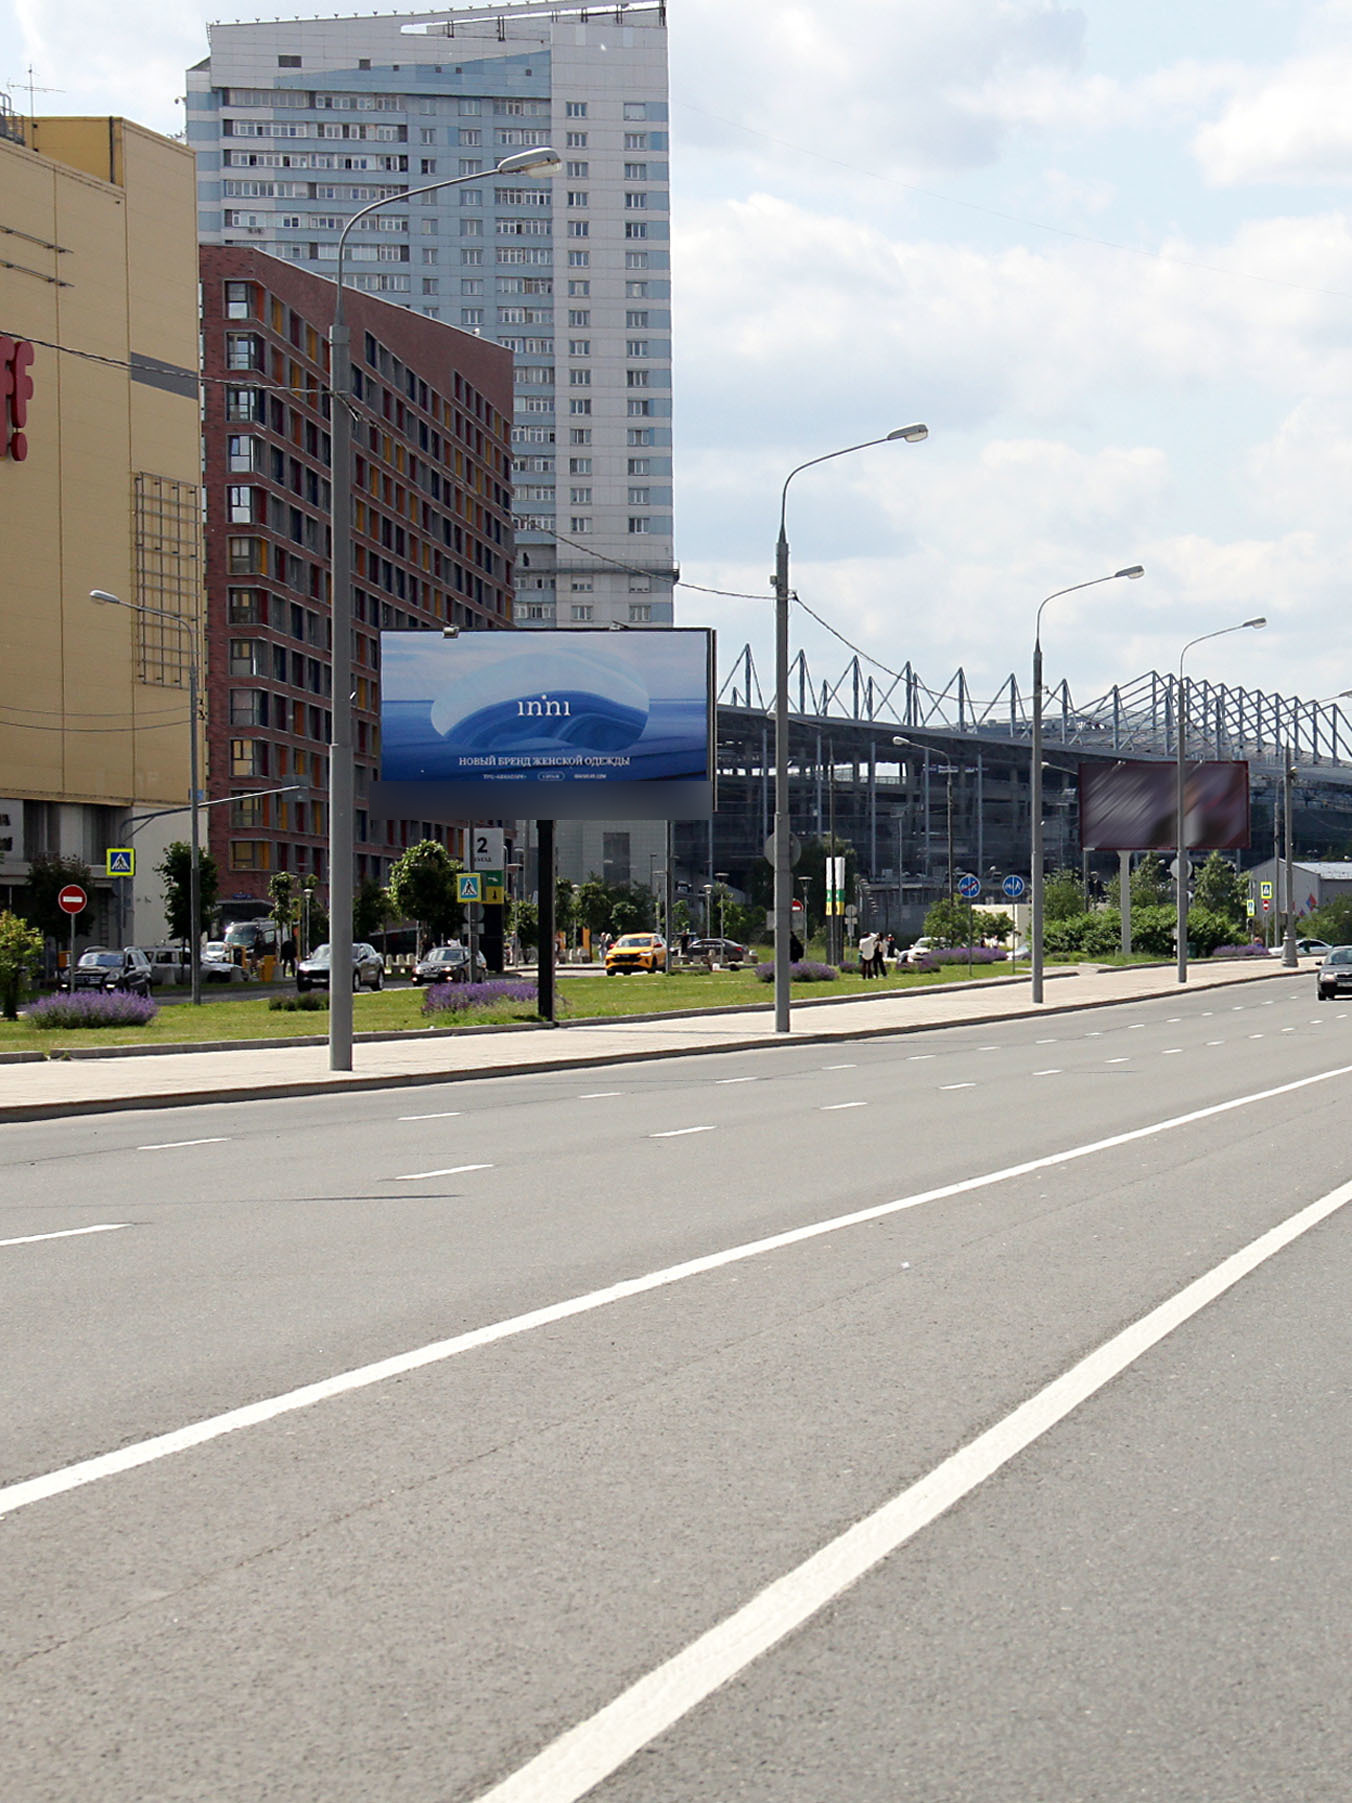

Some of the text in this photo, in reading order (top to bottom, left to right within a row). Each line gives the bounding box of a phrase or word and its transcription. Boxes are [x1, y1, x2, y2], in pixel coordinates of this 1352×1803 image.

[517, 694, 572, 717] inni
[458, 755, 630, 767] НОВЫЙ БРЕНД ЖЕНСКОЙ ОДЕЖДЫ
[477, 836, 488, 854] 2
